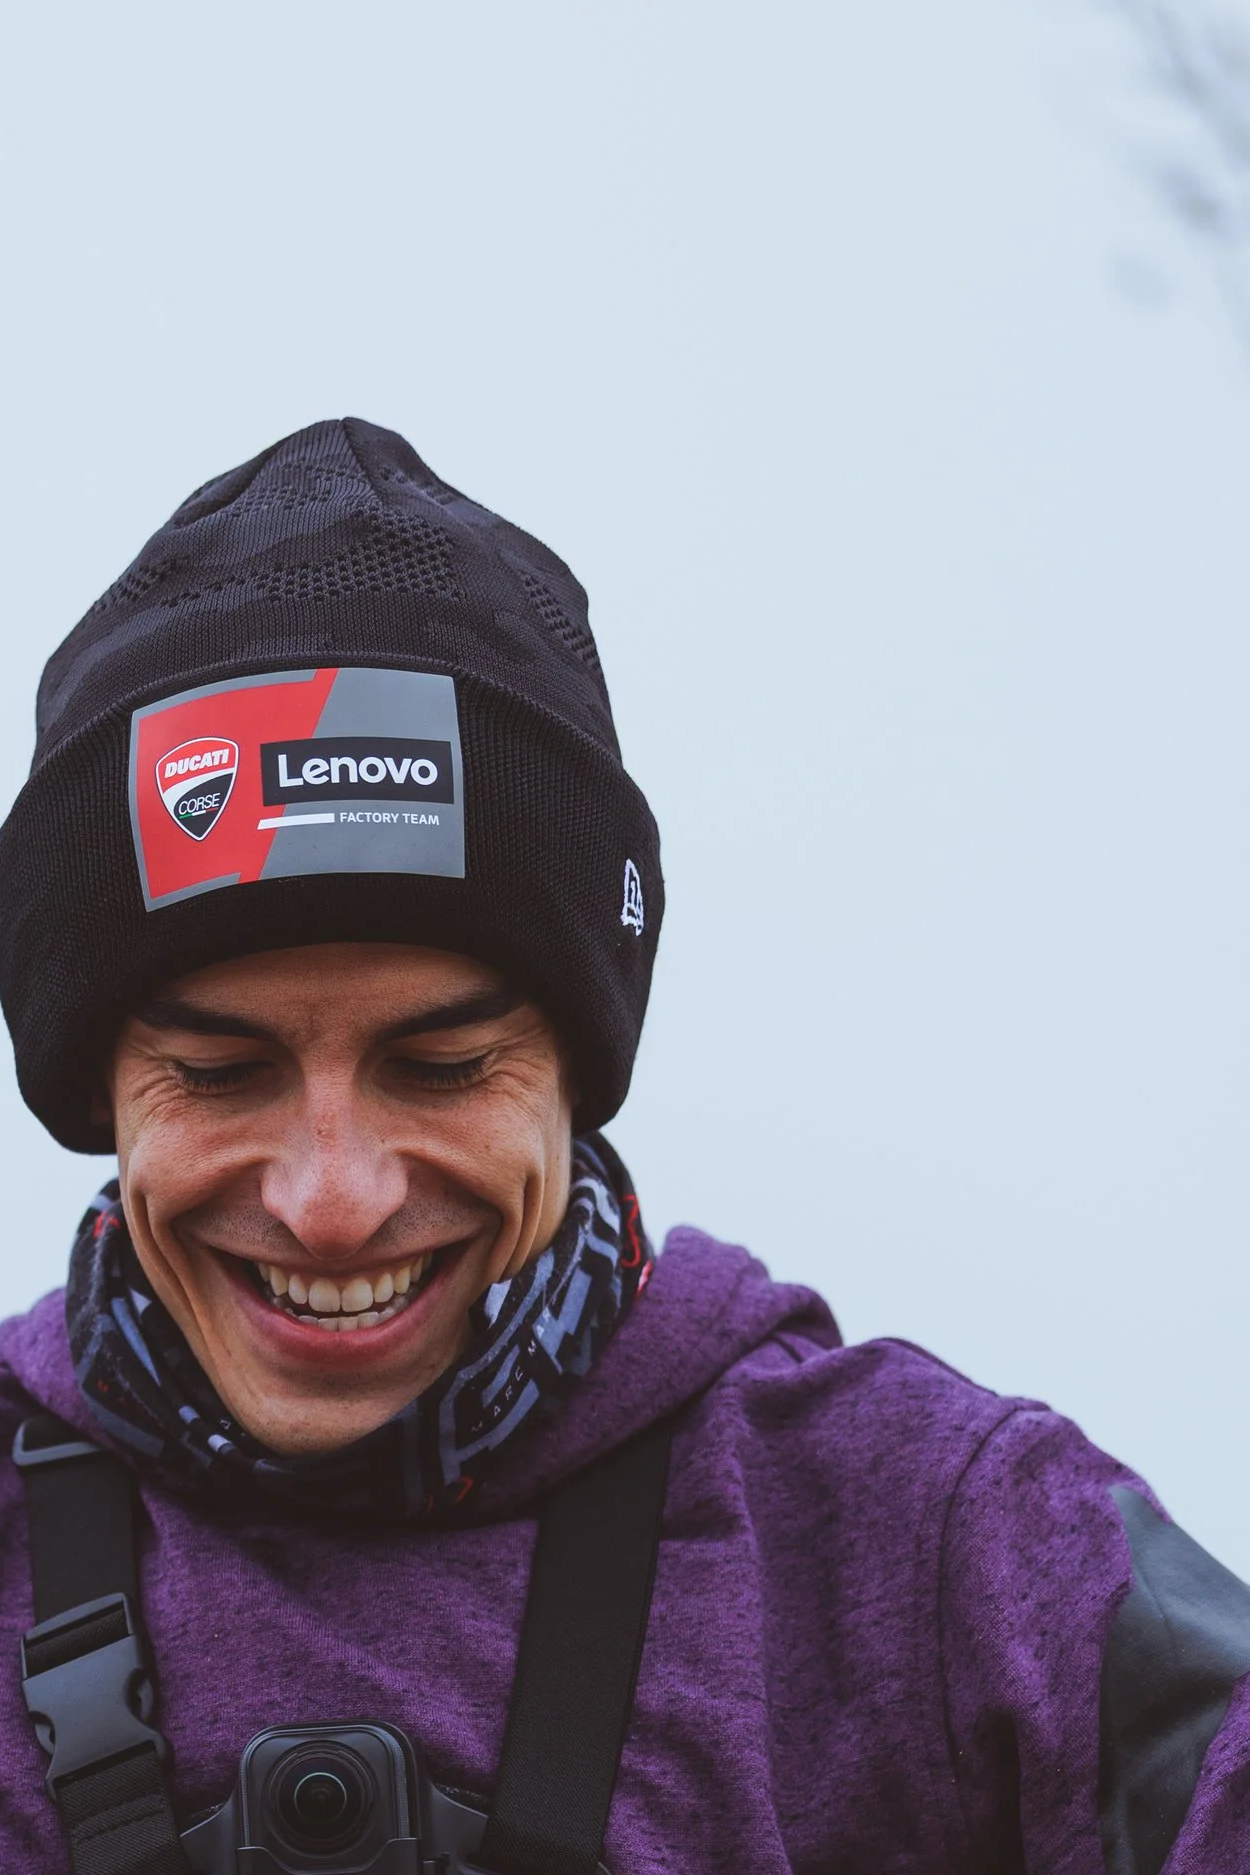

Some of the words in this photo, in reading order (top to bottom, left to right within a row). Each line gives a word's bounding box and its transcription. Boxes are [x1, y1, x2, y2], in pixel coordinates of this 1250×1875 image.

[164, 748, 229, 778] DUCATI
[278, 754, 438, 787] Lenovo
[178, 793, 221, 815] CORSE
[339, 811, 400, 824] FACTORY
[402, 813, 440, 826] TEAM
